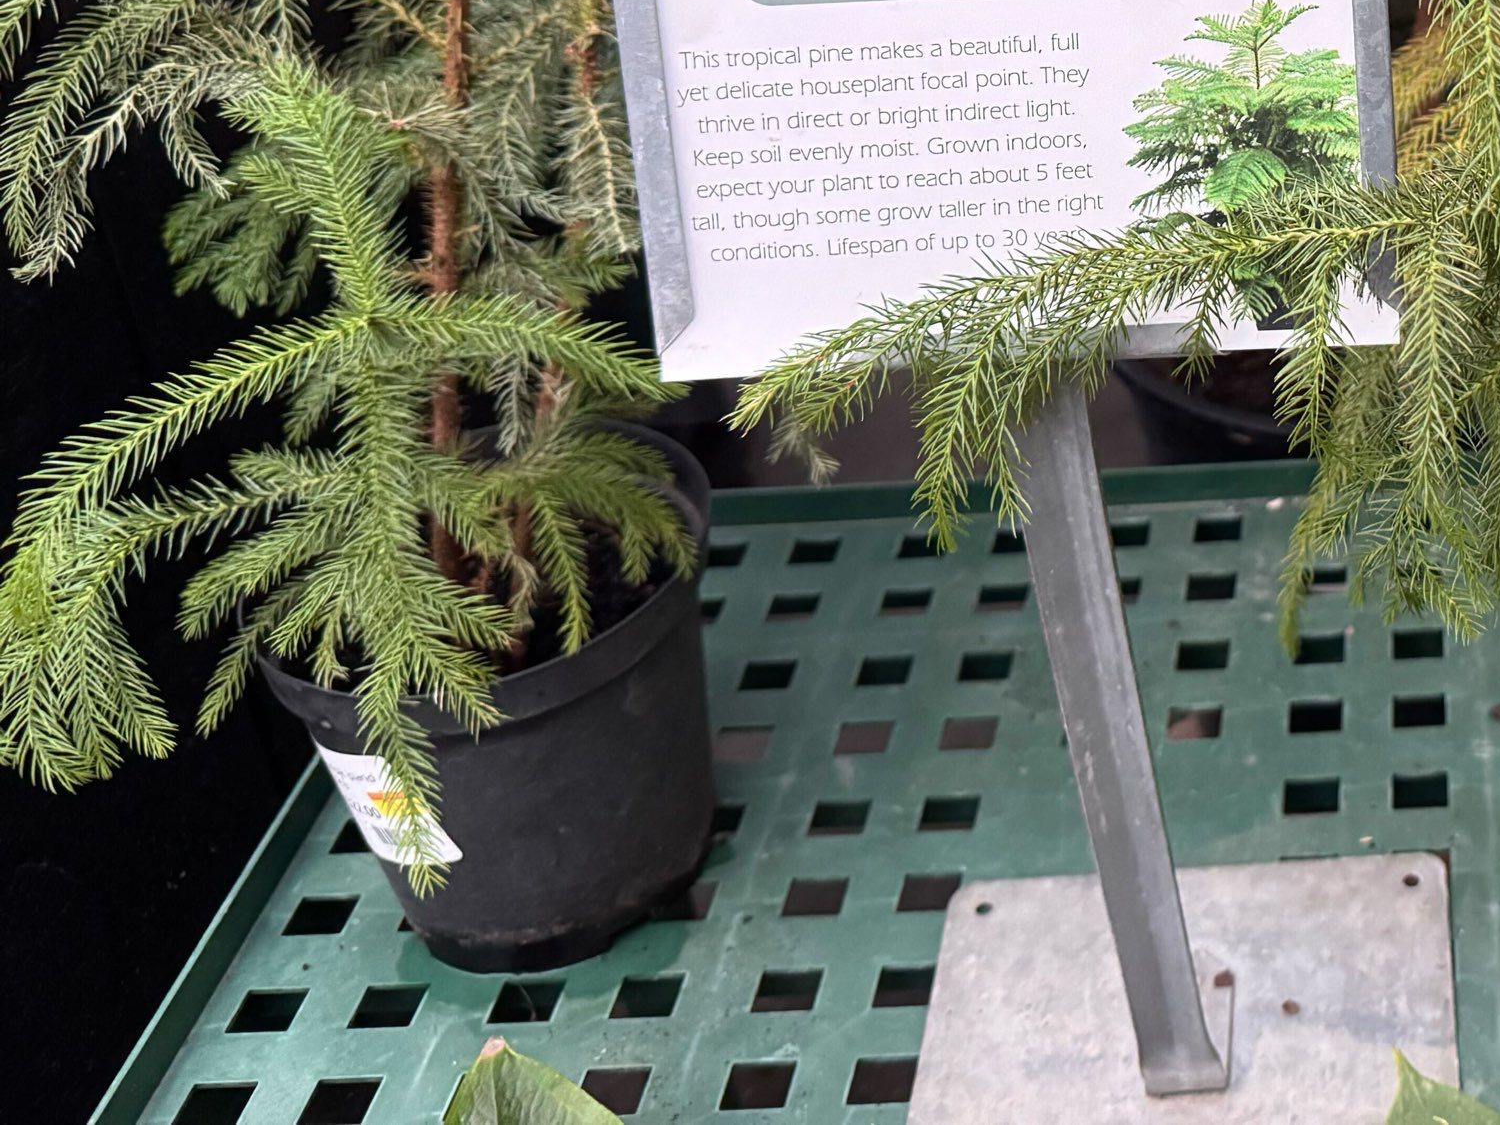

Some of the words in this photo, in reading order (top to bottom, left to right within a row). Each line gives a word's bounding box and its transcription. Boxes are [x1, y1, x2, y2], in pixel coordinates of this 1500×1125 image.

[679, 50, 720, 70] This
[726, 47, 801, 71] tropical
[809, 44, 853, 68] pine
[860, 41, 923, 60] makes
[930, 43, 942, 58] a
[950, 35, 1043, 56] beautiful,
[1051, 32, 1079, 51] full
[677, 86, 709, 107] yet
[716, 81, 793, 101] delicate
[801, 74, 915, 97] houseplant
[921, 71, 968, 90] focal
[976, 68, 1033, 92] point.
[1039, 67, 1090, 87] They
[698, 116, 755, 134] thrive
[762, 113, 780, 130] in
[787, 111, 843, 129] direct
[850, 112, 871, 126] or
[878, 105, 939, 129] bright
[945, 103, 1020, 121] indirect
[1026, 100, 1075, 122] light.
[693, 149, 743, 169] Keep
[750, 145, 781, 164] soil
[789, 142, 853, 164] evenly
[861, 140, 919, 158] moist.
[927, 136, 999, 155] Grown
[1006, 131, 1087, 151] indoors,
[697, 180, 764, 201] expect
[768, 178, 815, 200] your
[822, 174, 874, 196] plant
[879, 175, 900, 190] to
[906, 168, 963, 188] reach
[969, 166, 1029, 185] about
[1037, 163, 1048, 181] 5
[1055, 162, 1093, 180] feet
[692, 213, 725, 231] tall,
[733, 209, 809, 231] though
[816, 209, 870, 225] some
[877, 205, 932, 226] grow
[939, 200, 987, 219] taller
[993, 198, 1010, 216] in
[1018, 197, 1050, 214] the
[1057, 194, 1104, 217] right
[710, 241, 819, 262] conditions.
[827, 236, 908, 258] Lifespan
[915, 233, 936, 252] of
[942, 236, 969, 254] up
[976, 232, 995, 249] to
[1002, 228, 1027, 247] 30
